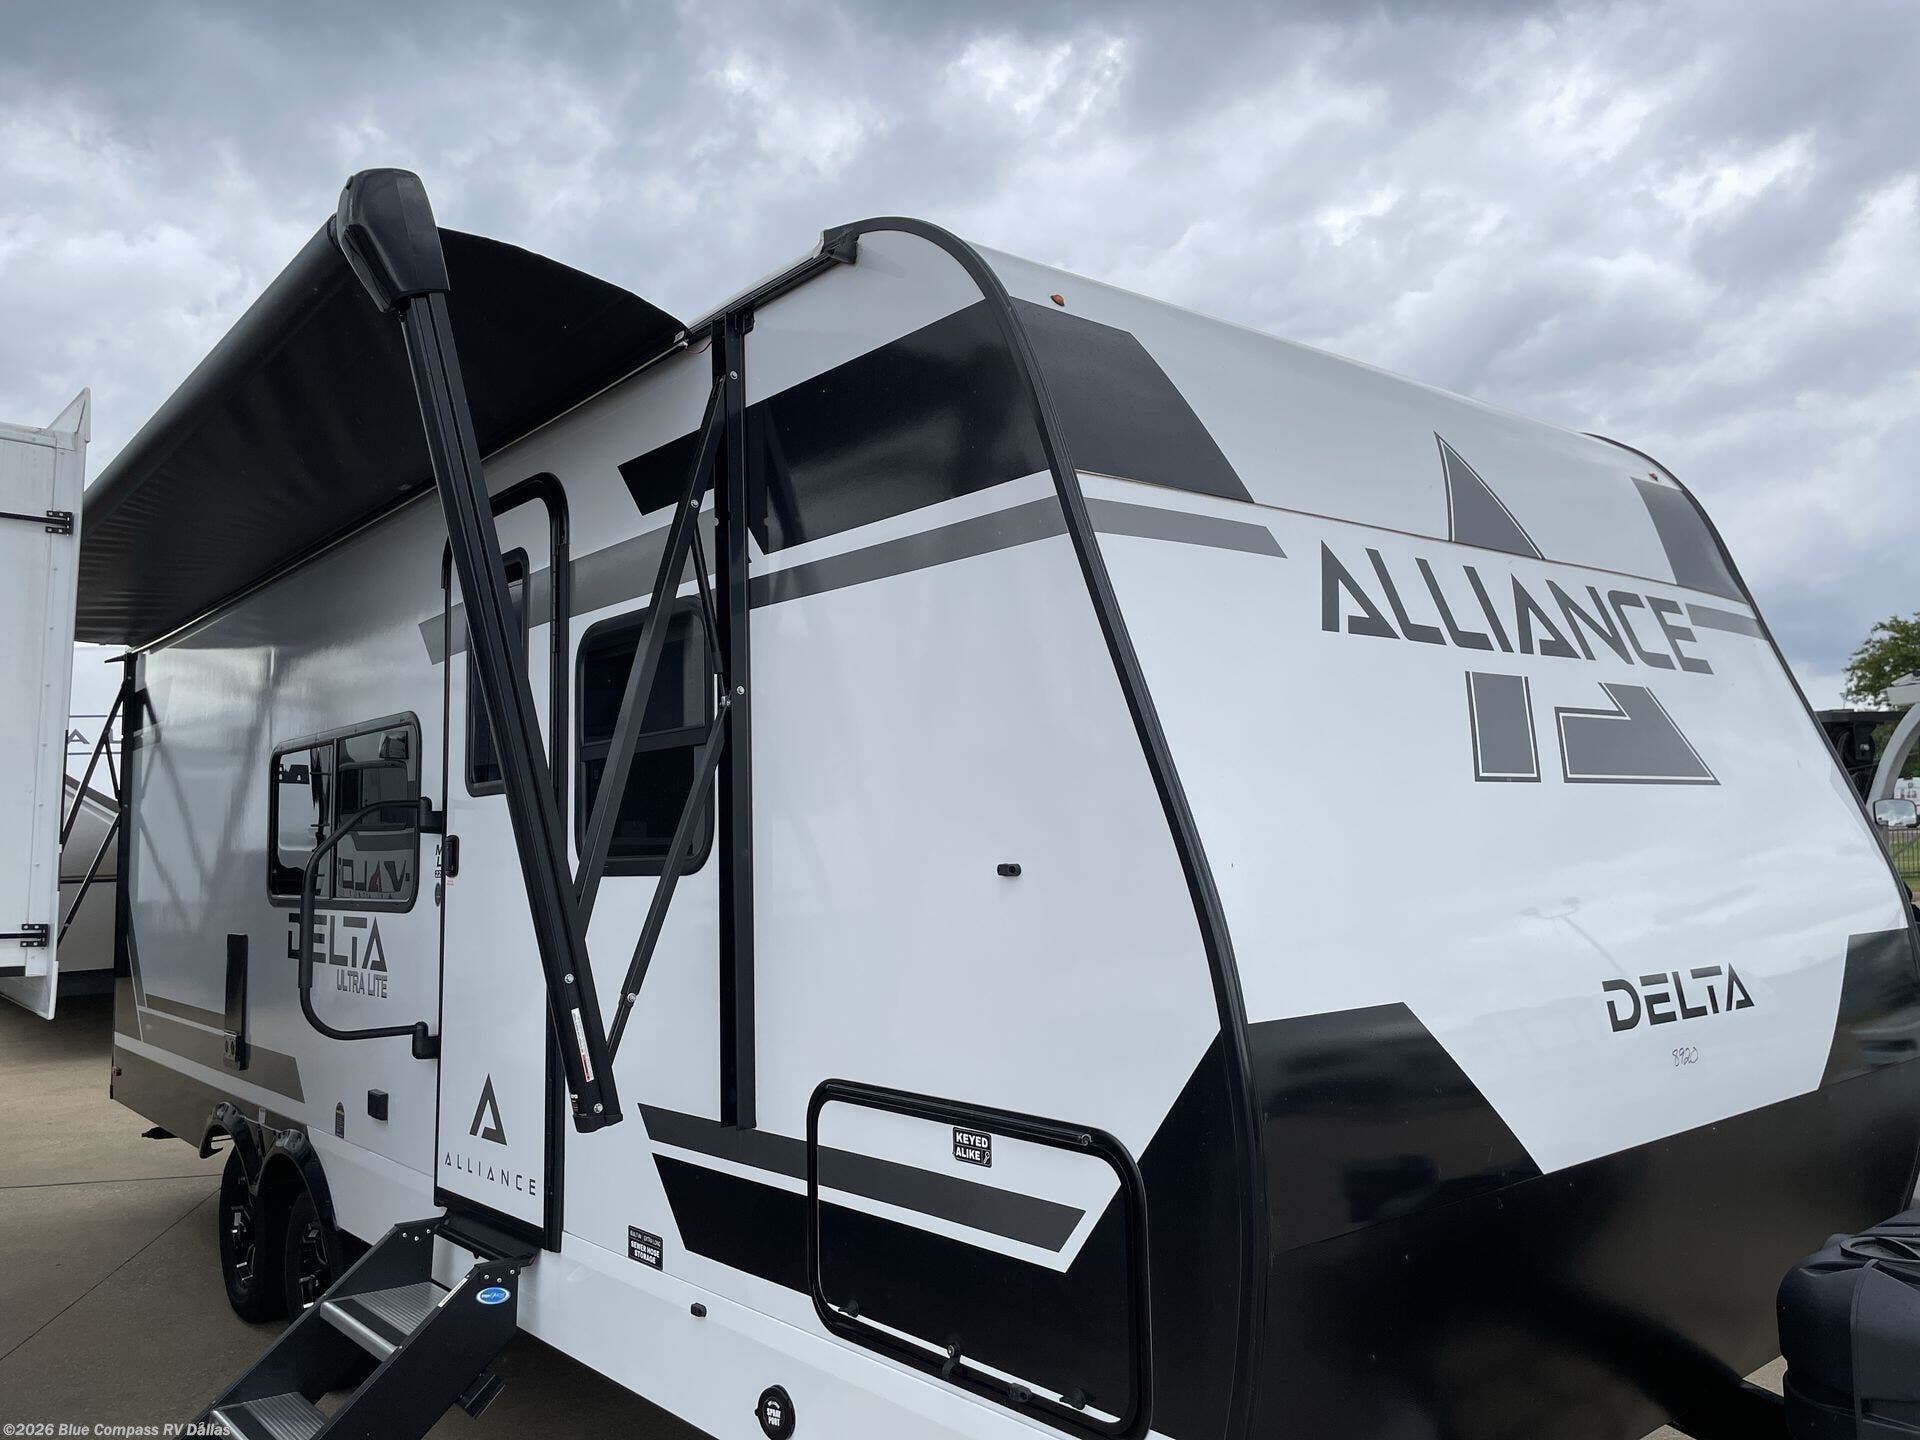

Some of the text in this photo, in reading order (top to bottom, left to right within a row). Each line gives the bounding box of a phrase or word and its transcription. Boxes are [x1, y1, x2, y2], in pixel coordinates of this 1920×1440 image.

[1320, 539, 1714, 675] ALLIANCE
[336, 969, 388, 999] ULTRA LITE
[1602, 962, 1755, 1032] DELTA
[1671, 1046, 1699, 1067] 8920
[956, 1131, 989, 1148] KEYED
[955, 1146, 981, 1161] ALIKE
[444, 1151, 536, 1196] ALLIANCE
[768, 1416, 780, 1427] PORT
